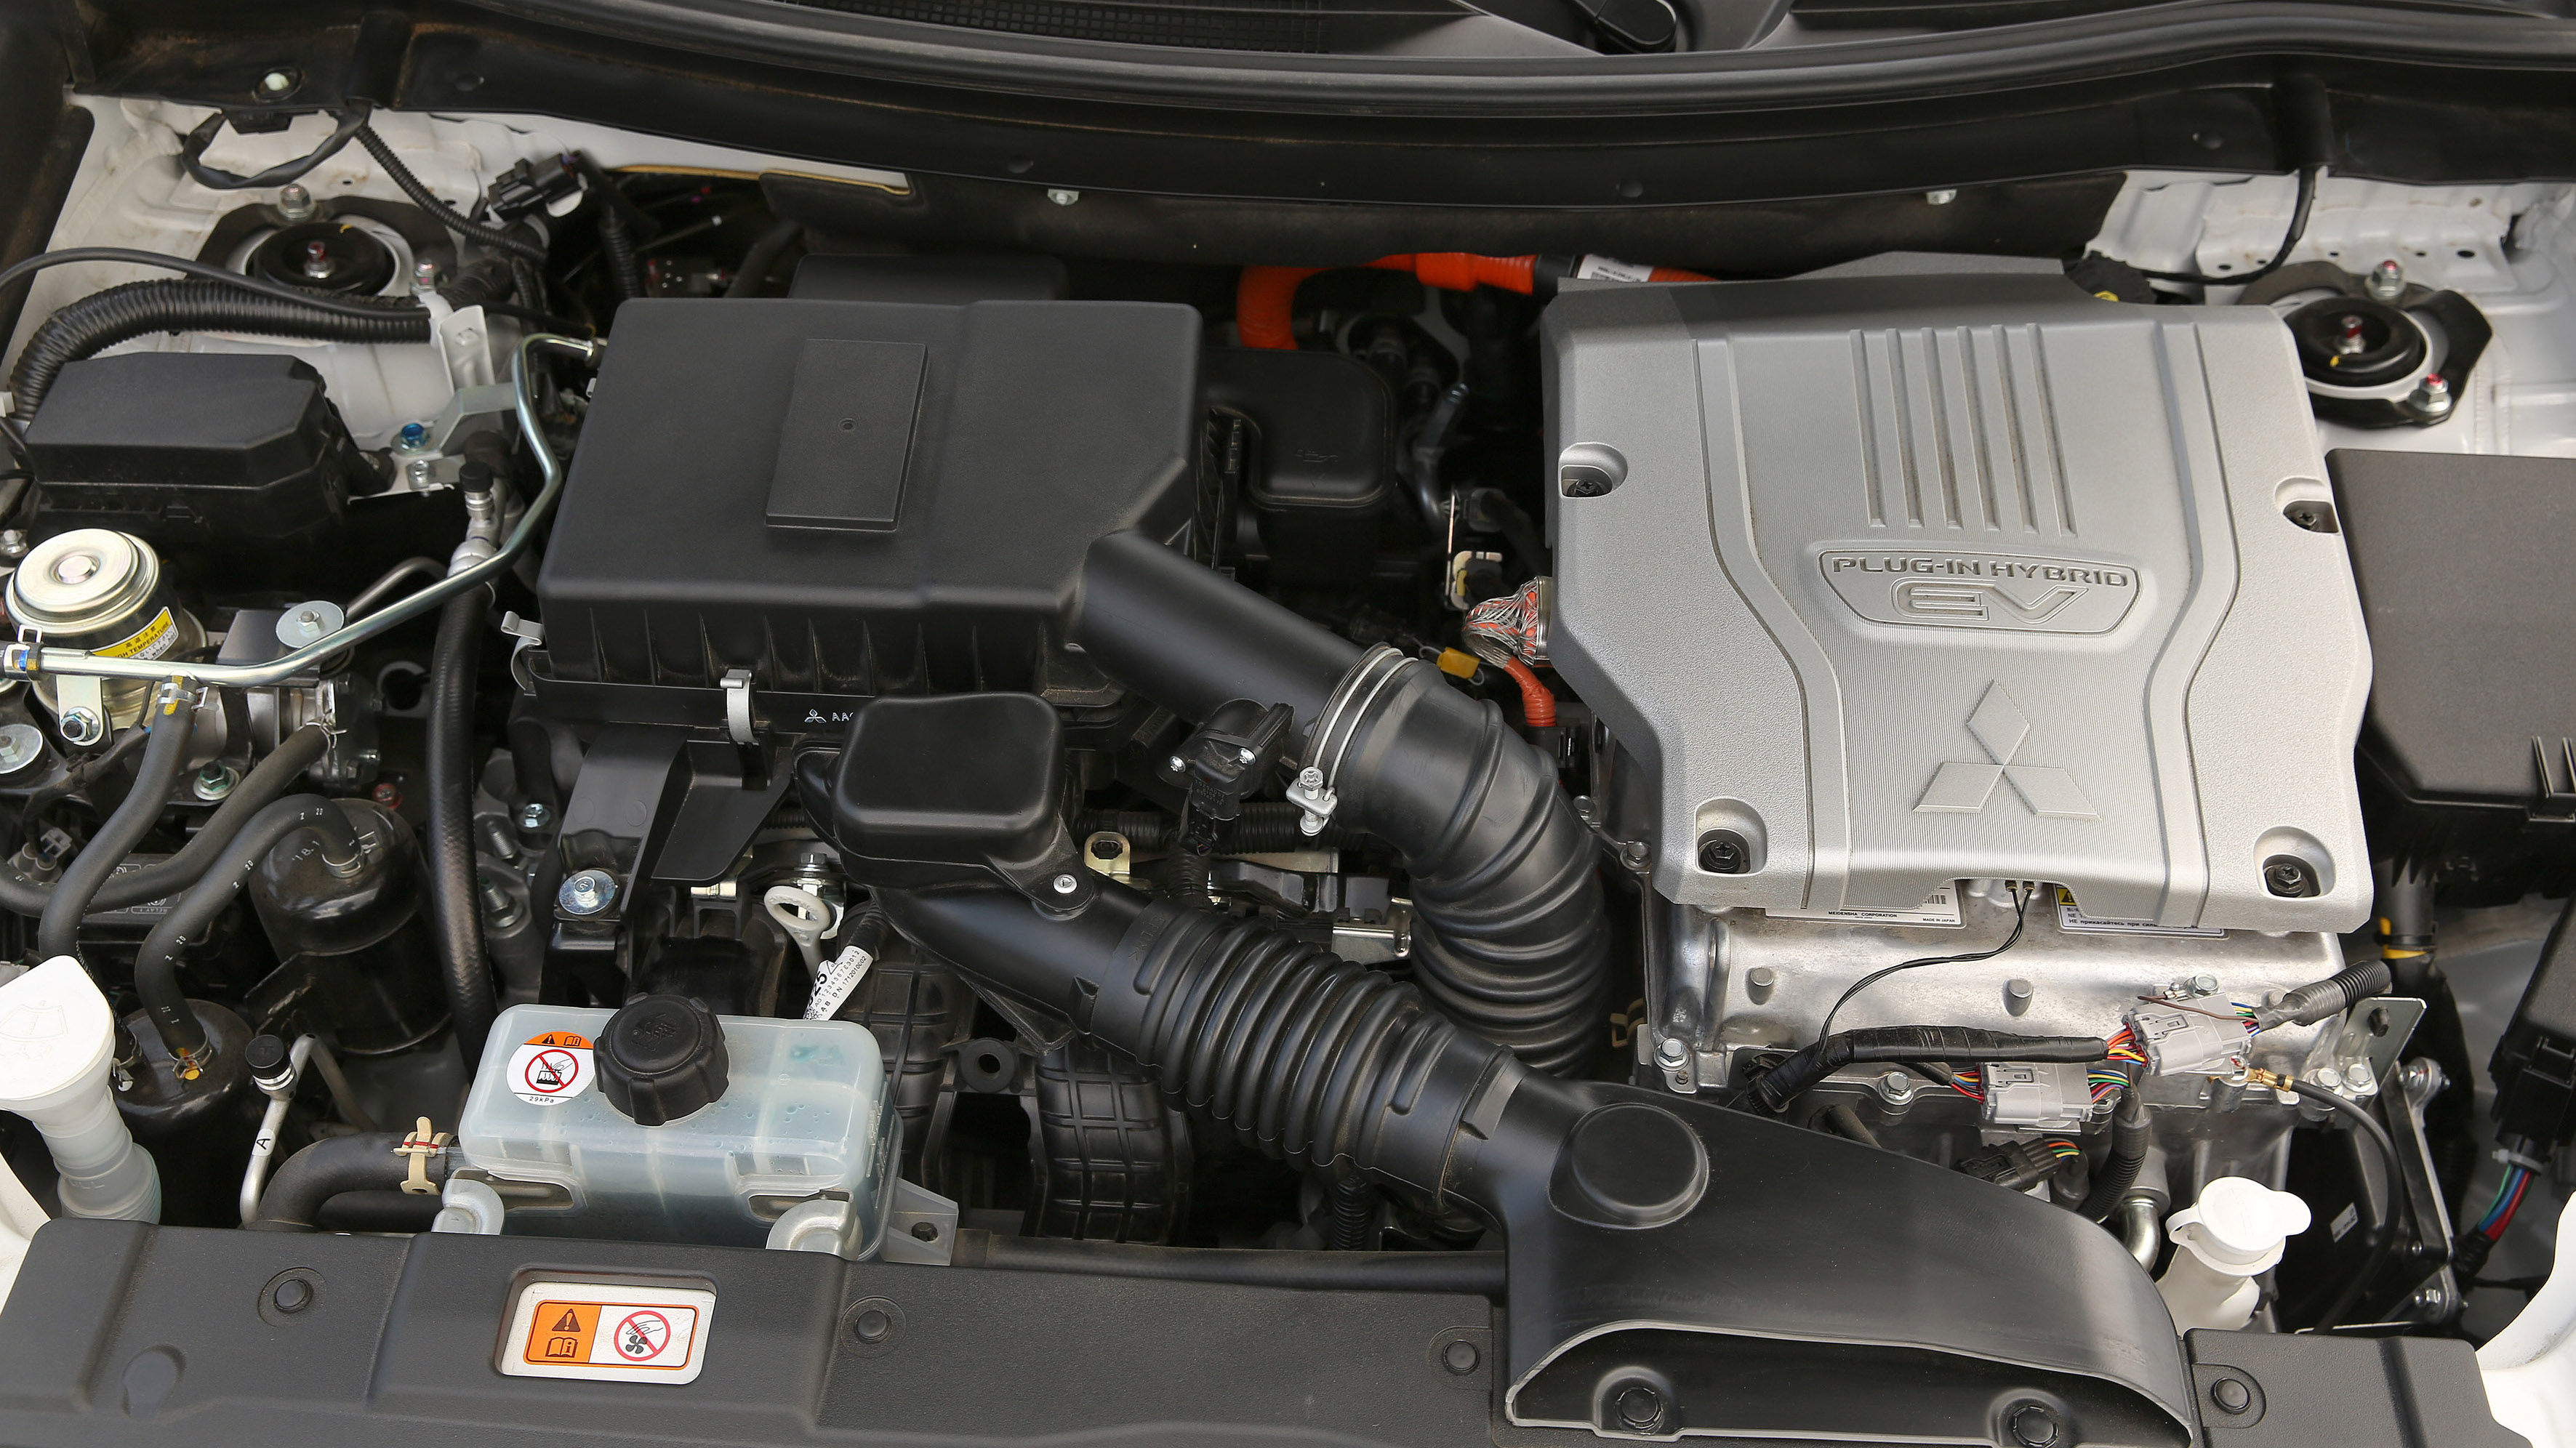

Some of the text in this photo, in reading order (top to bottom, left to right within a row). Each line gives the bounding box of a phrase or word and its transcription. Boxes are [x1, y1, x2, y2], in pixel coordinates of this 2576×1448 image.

[1832, 557, 2129, 588] PLUG-IN HYBRID
[1890, 576, 2088, 625] EV
[129, 622, 169, 654] TEMPERATURE
[832, 712, 854, 722] AA
[244, 860, 254, 871] 20
[176, 936, 186, 945] 20
[256, 1138, 271, 1150] A
